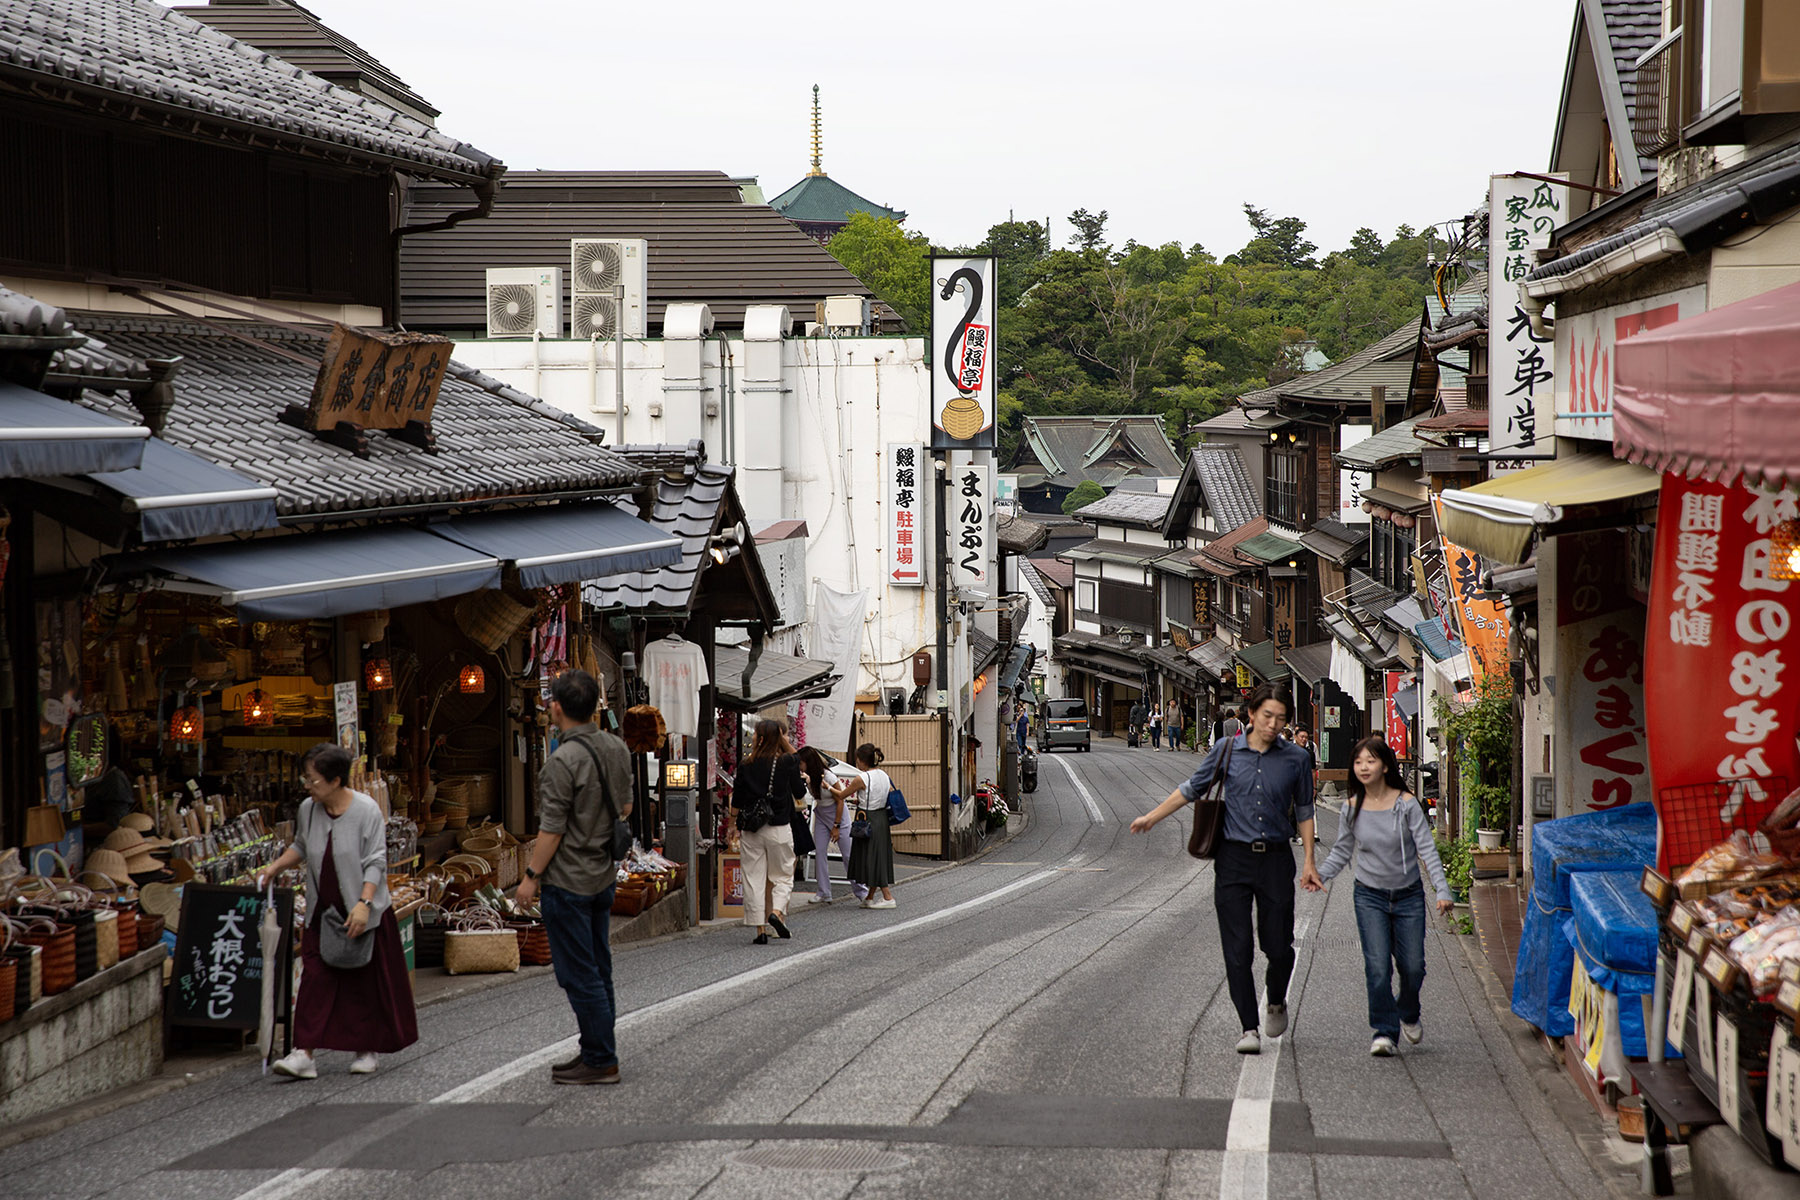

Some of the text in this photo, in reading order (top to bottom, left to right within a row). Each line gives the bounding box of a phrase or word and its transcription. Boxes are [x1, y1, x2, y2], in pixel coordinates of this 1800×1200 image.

[1527, 181, 1560, 235] 瓜の
[958, 470, 984, 576] まんぷく
[207, 909, 246, 1020] 大根おろし
